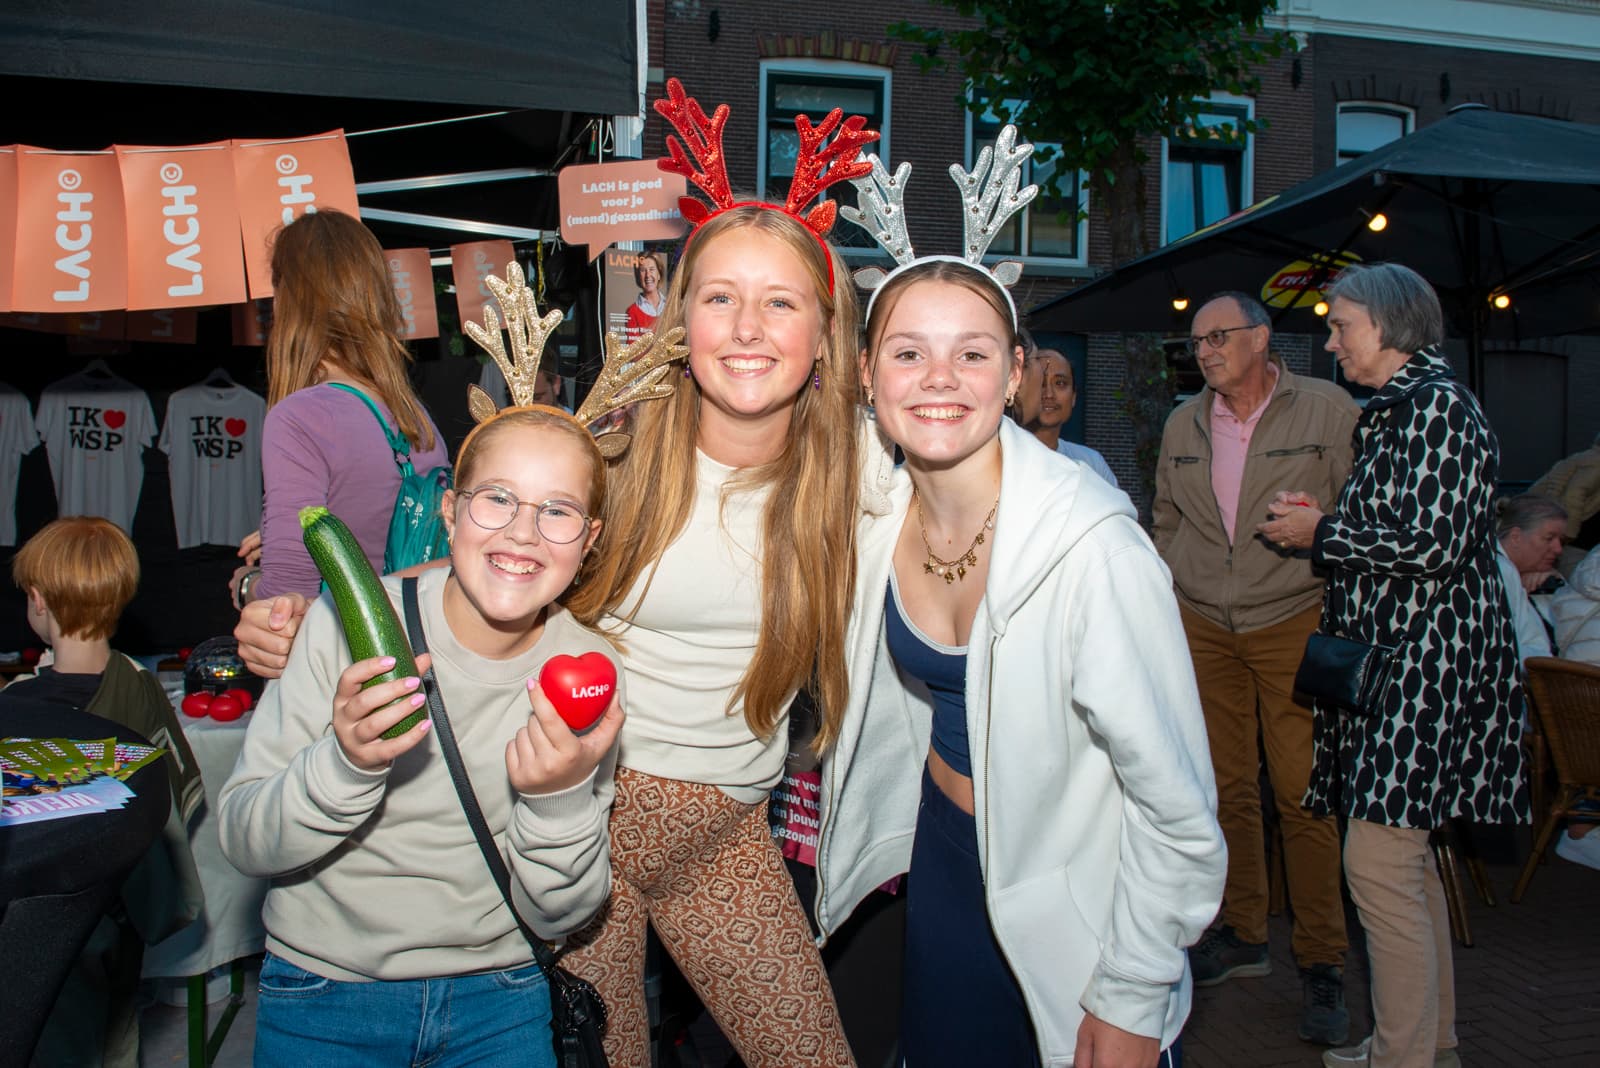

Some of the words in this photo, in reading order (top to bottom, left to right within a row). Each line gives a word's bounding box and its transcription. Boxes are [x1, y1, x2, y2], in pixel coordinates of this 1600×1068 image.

[582, 181, 616, 194] LACH
[601, 197, 629, 208] voor
[52, 192, 94, 303] LACH
[161, 185, 204, 297] LACH
[68, 406, 103, 428] IK
[190, 416, 223, 436] IK
[69, 428, 123, 451] WSP
[192, 439, 244, 459] WSP
[571, 685, 604, 699] LACH
[782, 775, 800, 788] eer
[771, 789, 801, 805] jouw
[788, 809, 820, 829] jouw
